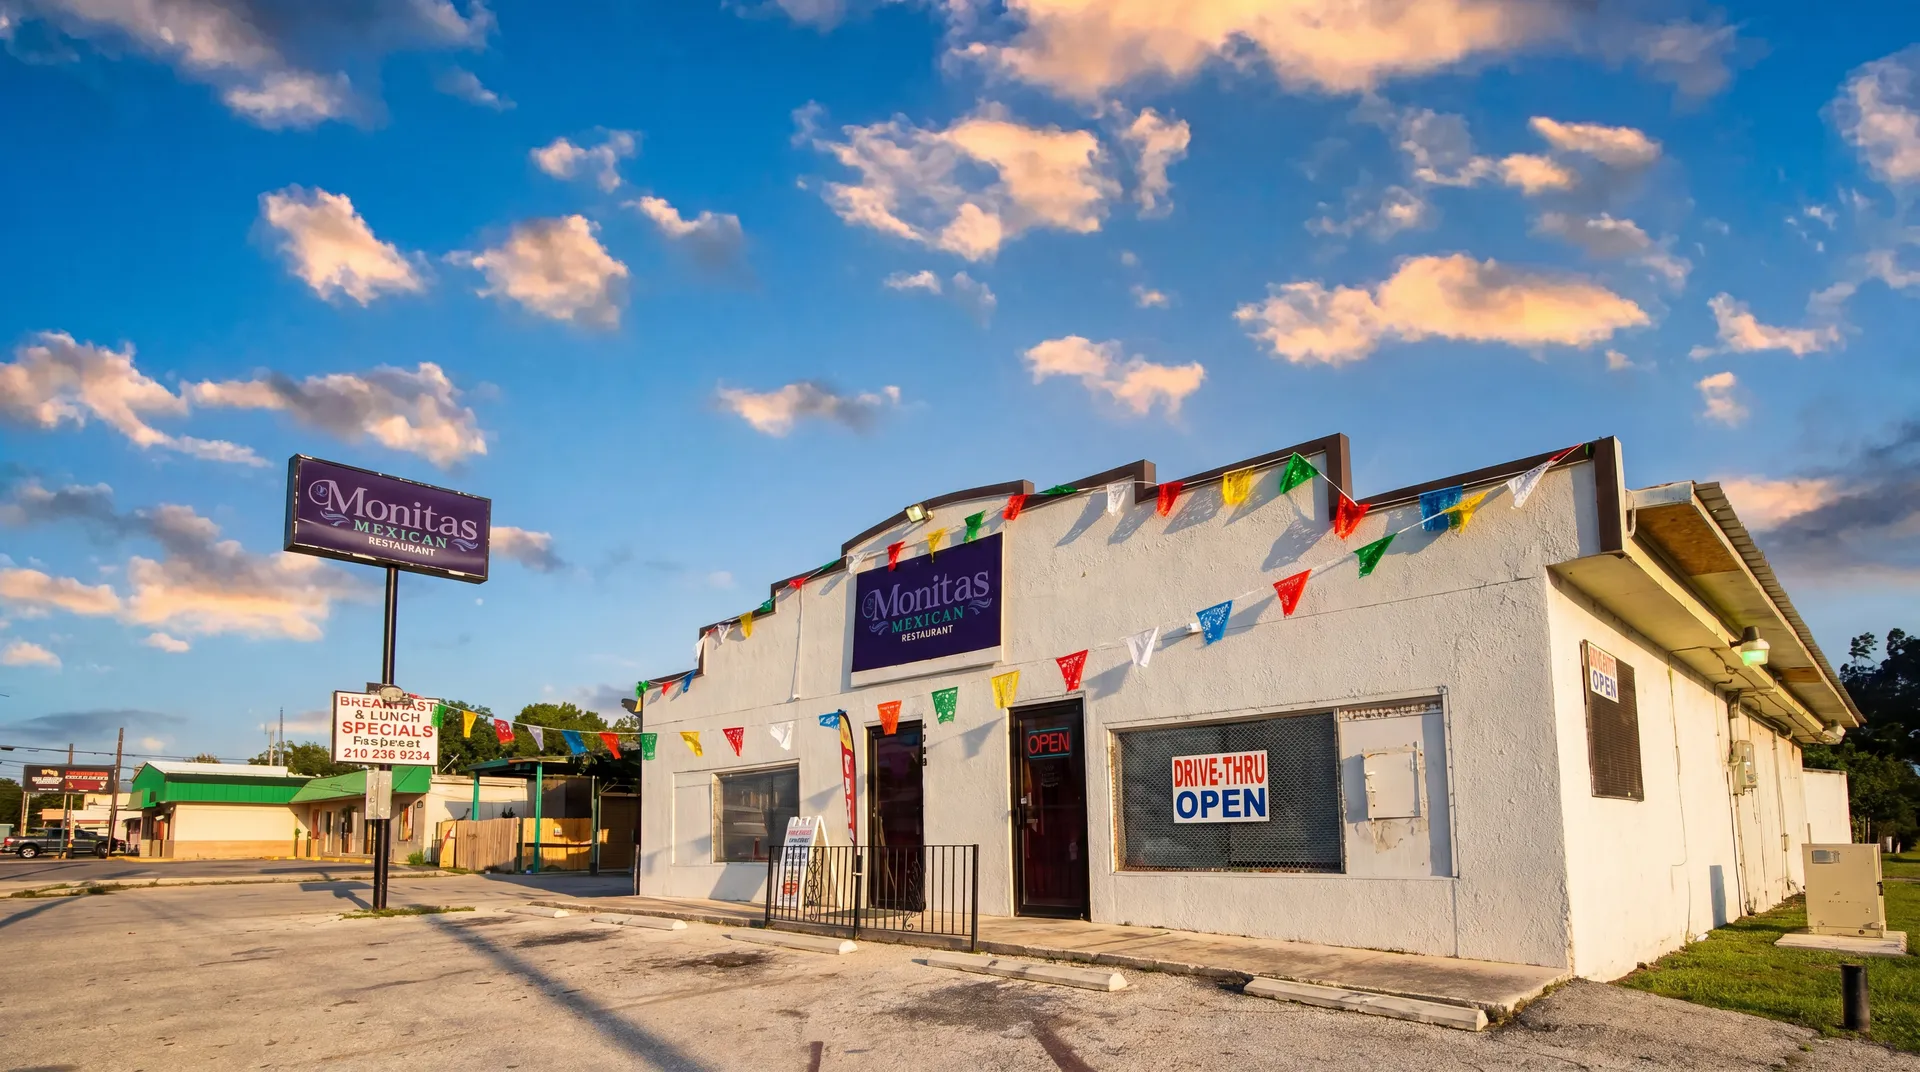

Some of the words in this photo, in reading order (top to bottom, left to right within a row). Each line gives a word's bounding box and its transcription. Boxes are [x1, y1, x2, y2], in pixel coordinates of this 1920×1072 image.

[308, 479, 478, 541] Monitas
[353, 519, 448, 549] MEXICAN
[368, 536, 436, 557] RESTAURANT
[861, 570, 991, 622] Monitas
[891, 605, 965, 634] MEXICAN
[901, 624, 954, 643] RESTAURANT
[1592, 669, 1617, 699] OPEN
[342, 721, 434, 738] SPECIALS
[354, 709, 365, 720] &
[370, 710, 421, 723] LUNCH
[343, 747, 368, 759] 210
[372, 748, 396, 760] 236
[399, 750, 431, 761] 9234
[1028, 732, 1070, 754] OPEN
[1174, 753, 1265, 788] DRIVE-THRU
[1176, 787, 1266, 819] OPEN
